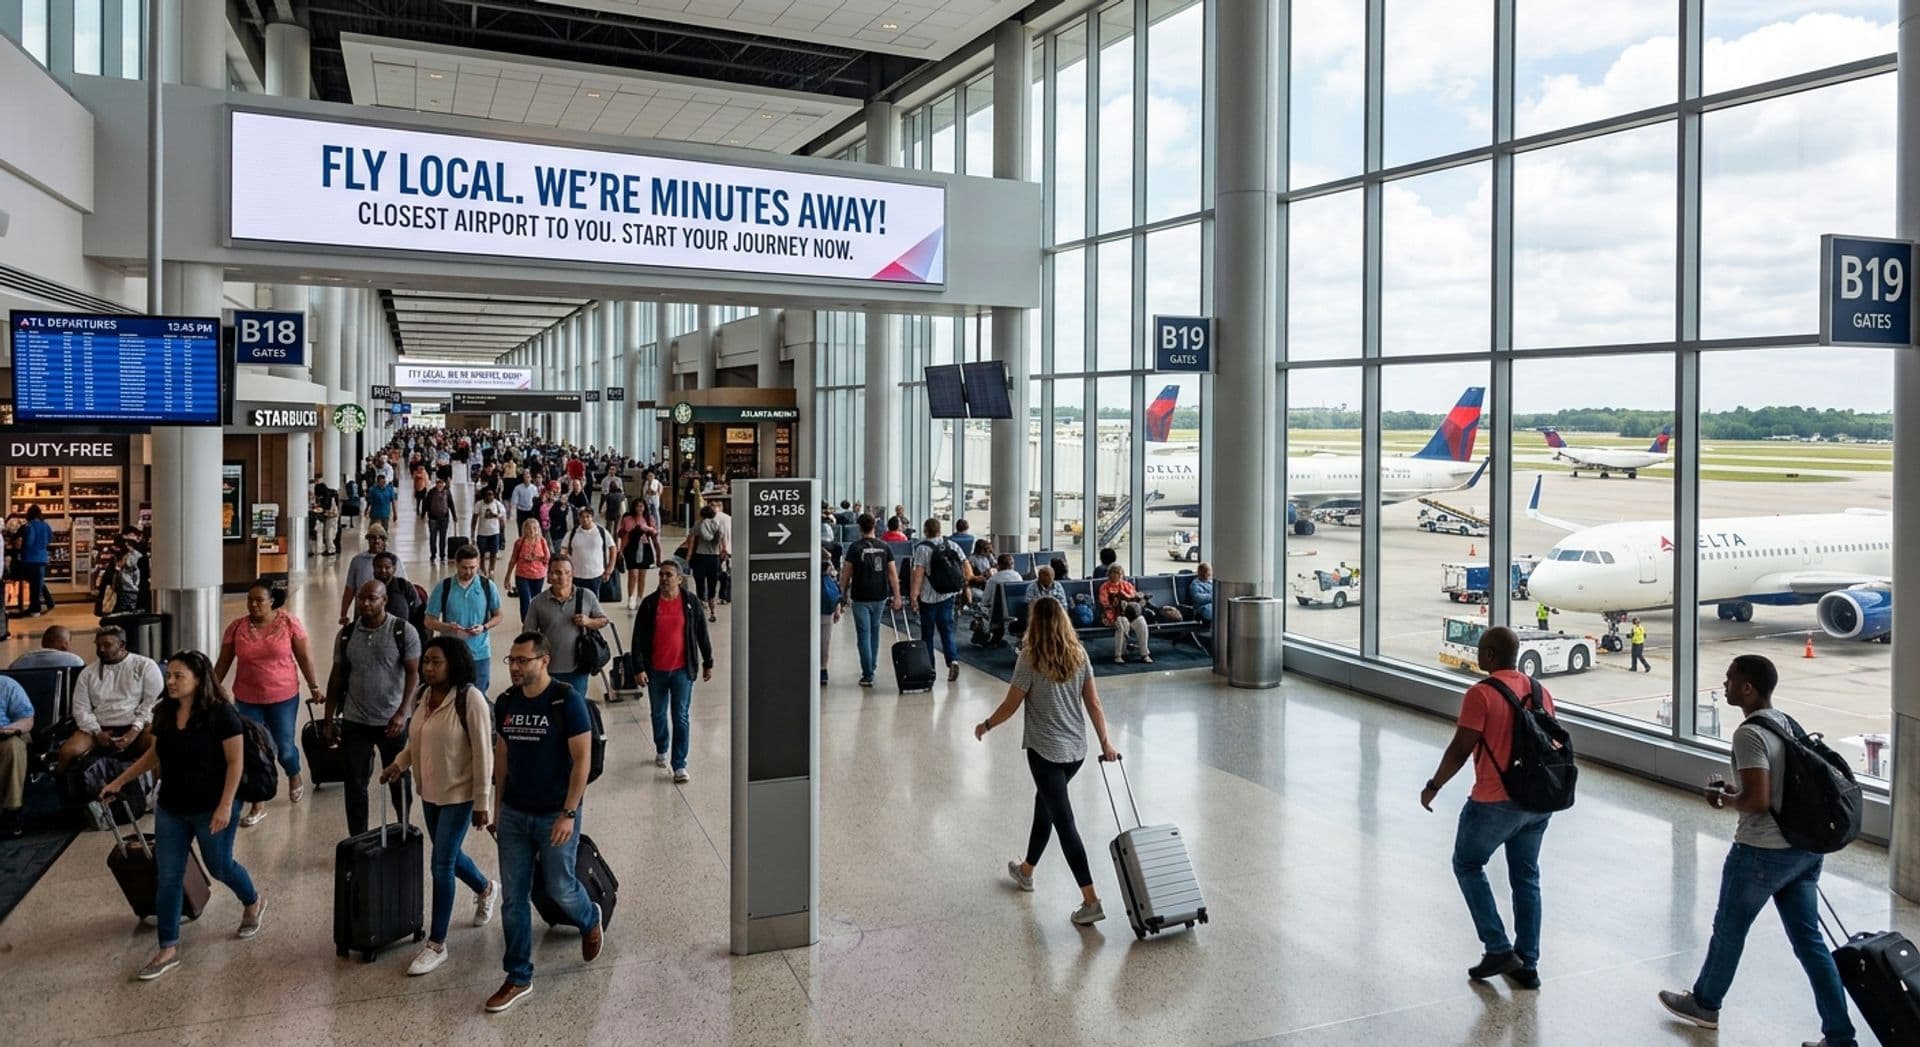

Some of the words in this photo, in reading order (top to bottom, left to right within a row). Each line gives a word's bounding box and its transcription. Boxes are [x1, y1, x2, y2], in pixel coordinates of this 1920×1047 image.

[322, 144, 387, 192] FLY
[399, 152, 524, 205] LOCAL.
[534, 165, 641, 214] WE’RE
[651, 177, 790, 227] MINUTES
[798, 192, 886, 235] AWAY!
[358, 201, 449, 230] CLOSEST
[454, 208, 540, 237] AIRPORT
[545, 215, 569, 240] TO
[574, 218, 617, 243] YOU.
[622, 222, 678, 247] START
[682, 227, 728, 251] YOUR
[733, 231, 809, 257] JOURNEY
[813, 238, 854, 260] NOW.
[1840, 254, 1904, 303] B19
[20, 317, 45, 327] ATL
[47, 317, 118, 330] DEPARTURES
[196, 323, 213, 333] PM
[1852, 312, 1892, 329] GATES
[241, 319, 296, 344] B18
[1161, 325, 1205, 351] B19
[252, 348, 287, 358] GATES
[1169, 354, 1198, 364] GATES
[11, 442, 114, 457] DUTY-FREE
[1146, 464, 1193, 474] DELTA
[759, 489, 801, 502] GATES
[1696, 533, 1747, 549] ELTA
[751, 571, 808, 582] DEPARTURES
